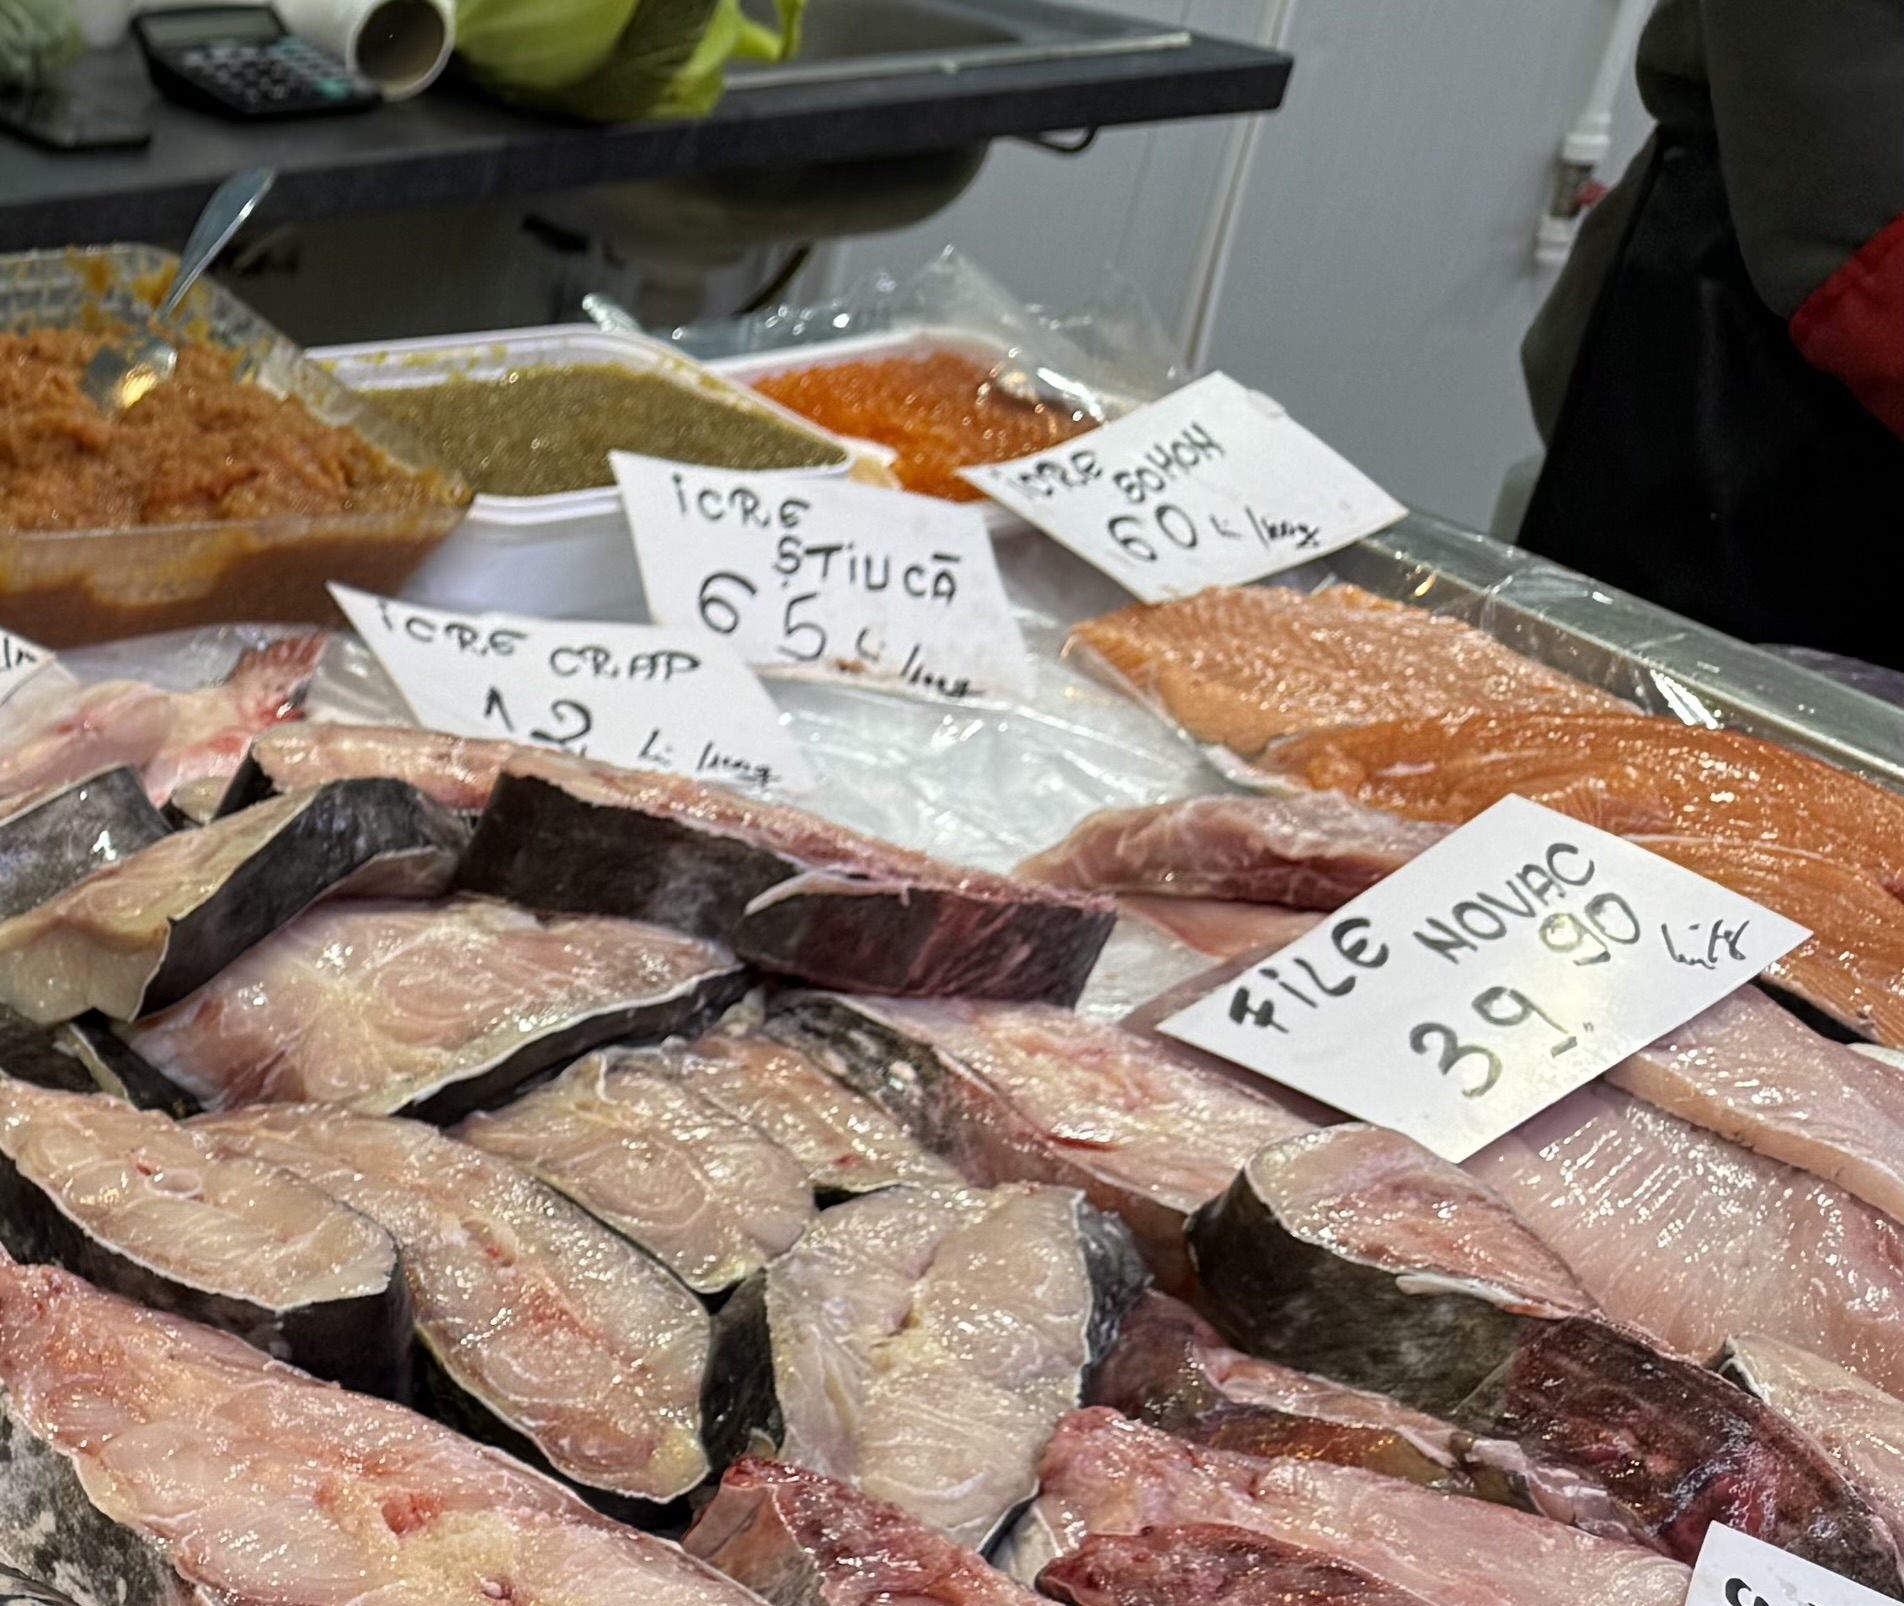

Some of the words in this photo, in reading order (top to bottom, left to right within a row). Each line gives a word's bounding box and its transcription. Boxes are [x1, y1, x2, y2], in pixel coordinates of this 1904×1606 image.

[1106, 503, 1198, 563] 60
[697, 571, 828, 662] 65
[549, 646, 702, 681] CRAP
[483, 684, 593, 745] 12
[1412, 842, 1596, 964] NOVAC
